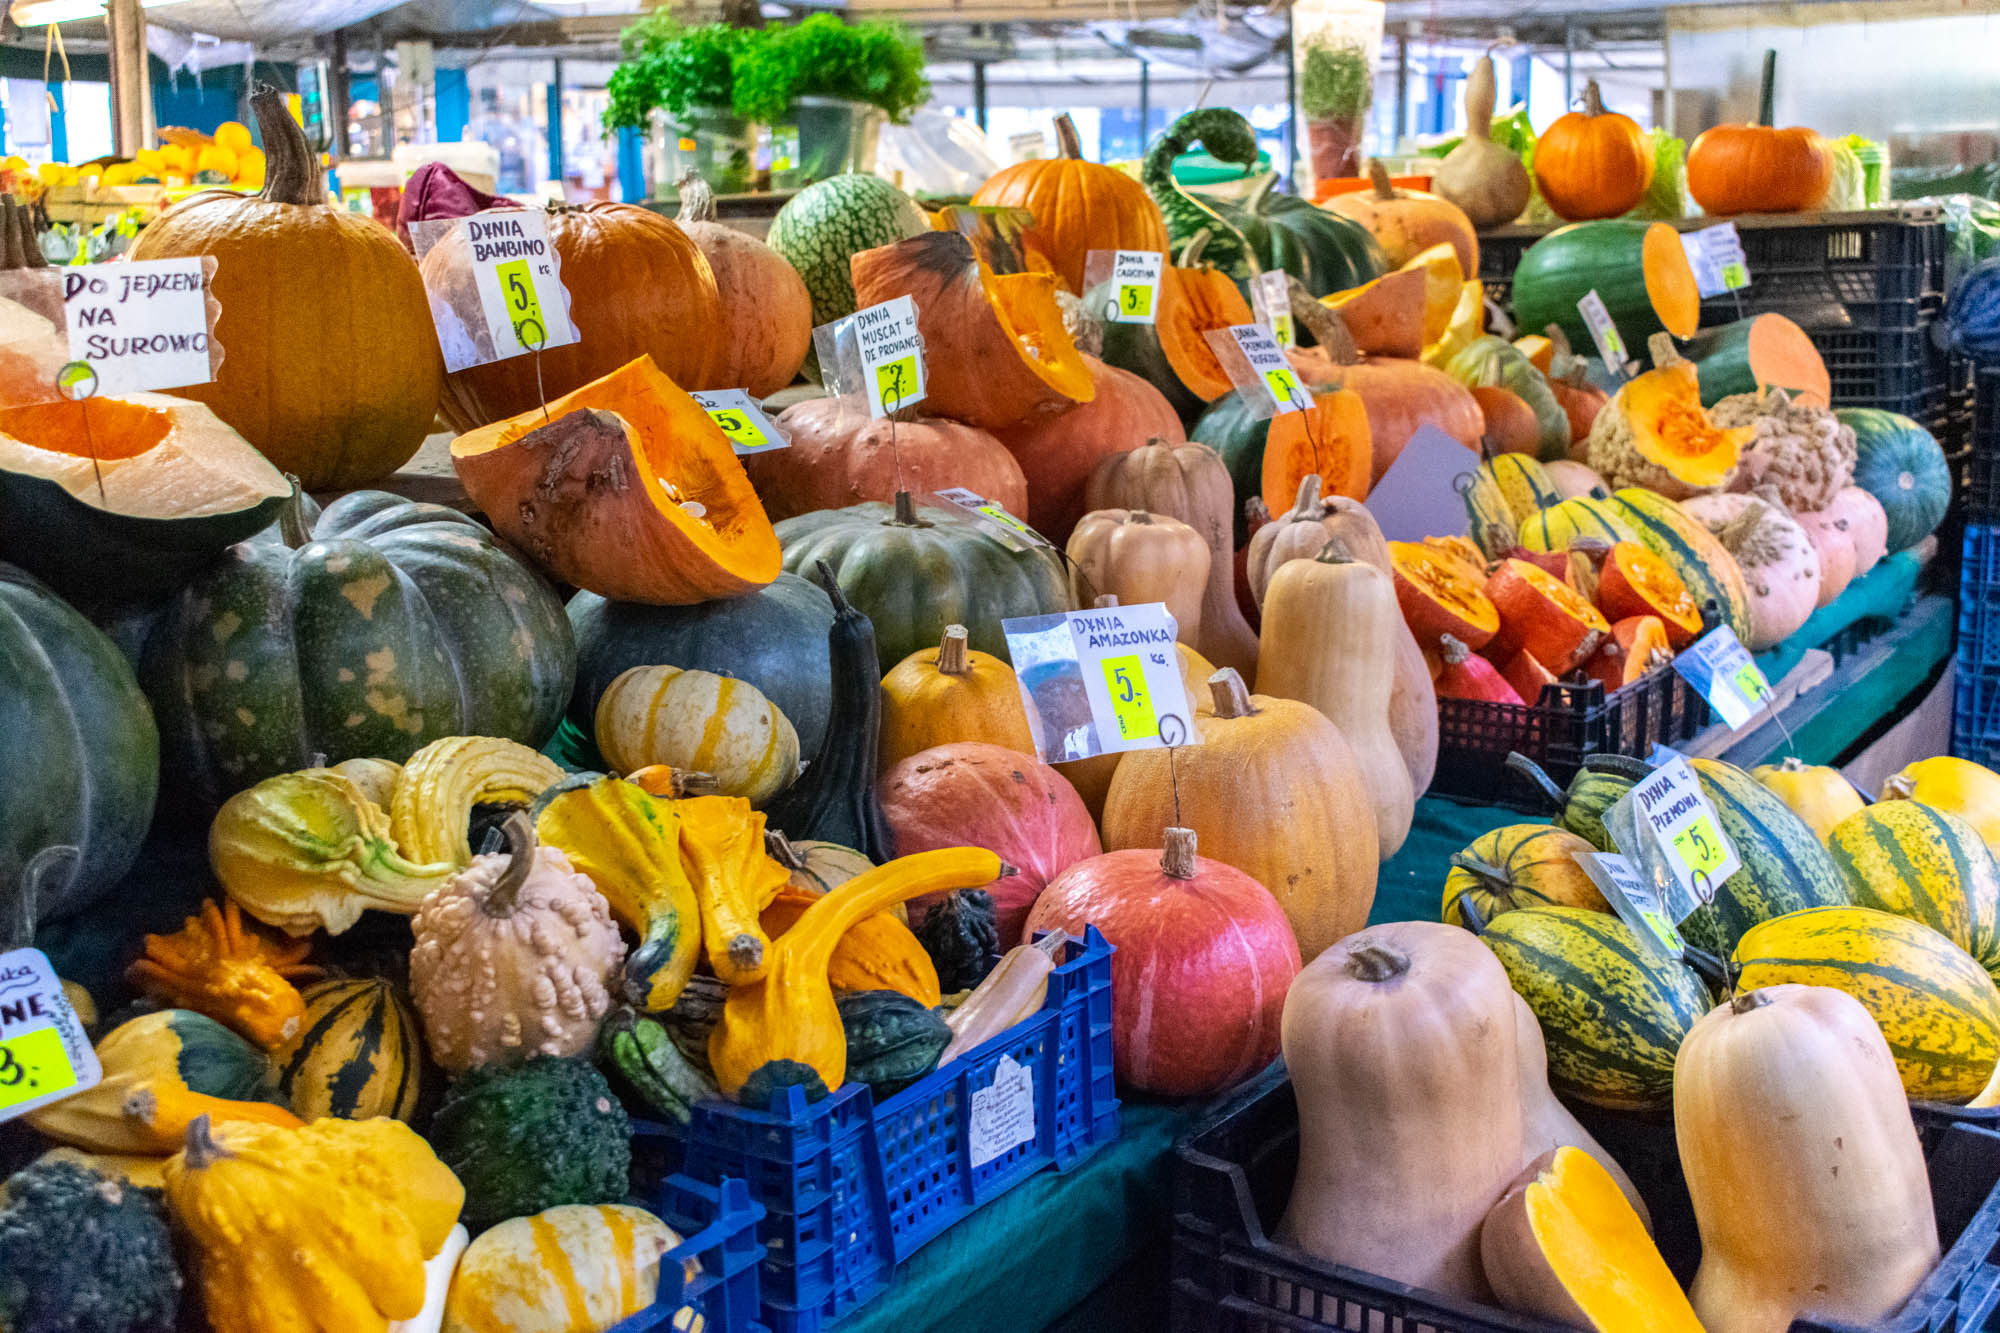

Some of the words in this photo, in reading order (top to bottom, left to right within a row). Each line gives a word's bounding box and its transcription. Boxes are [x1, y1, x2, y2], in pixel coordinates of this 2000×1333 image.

[468, 220, 525, 241] DYNIA
[473, 239, 545, 261] BAMBINO
[78, 307, 117, 328] NA
[857, 306, 891, 330] DYNIA
[862, 321, 902, 347] MUSCAT
[85, 332, 209, 360] SUROWO
[864, 348, 877, 364] DE
[879, 335, 921, 358] PROVANCE
[1072, 616, 1125, 635] DYNIA
[1089, 628, 1172, 649] AMAZONKA
[1637, 775, 1677, 813] DYNIA
